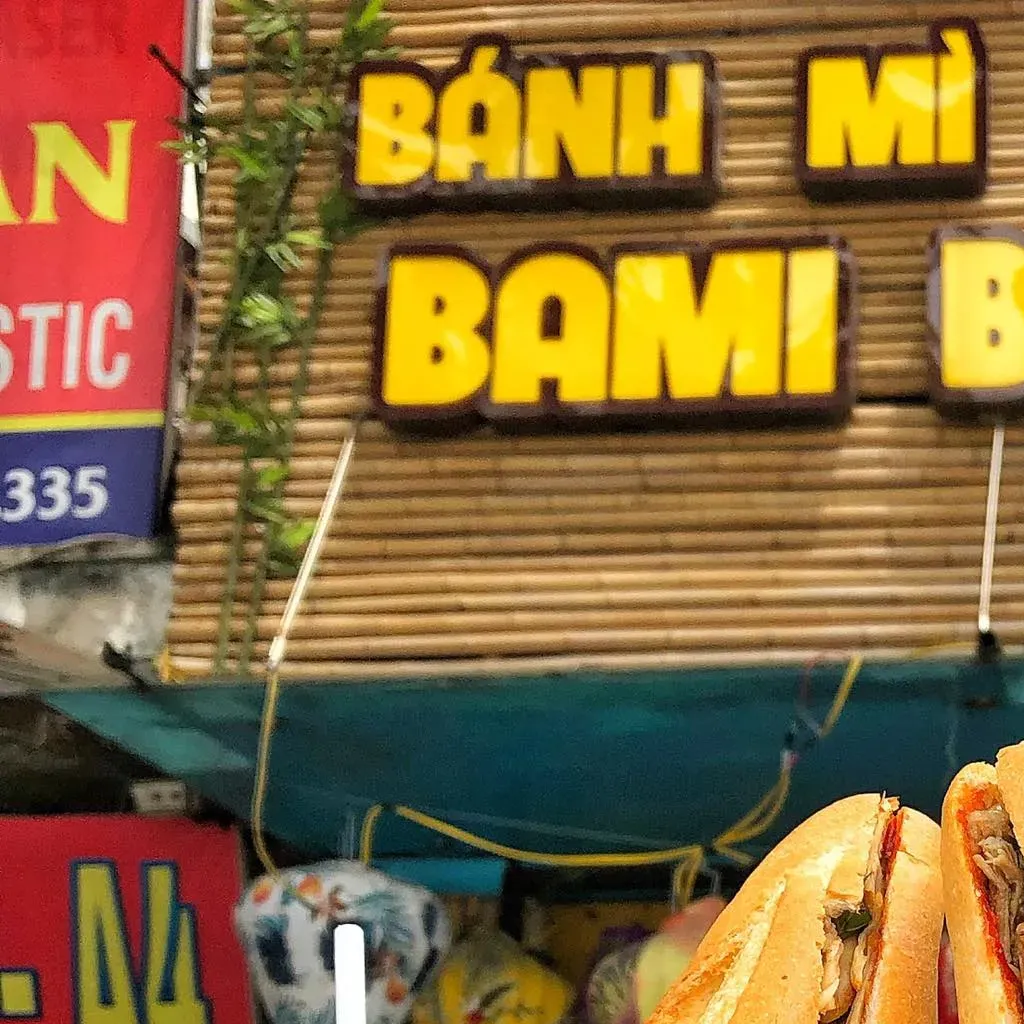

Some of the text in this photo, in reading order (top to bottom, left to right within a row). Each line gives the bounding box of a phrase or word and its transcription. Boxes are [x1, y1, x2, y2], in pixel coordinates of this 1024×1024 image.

[0, 119, 137, 225] N
[353, 44, 706, 187] BÁNH
[804, 26, 978, 169] MÌ
[379, 247, 841, 408] BAMI
